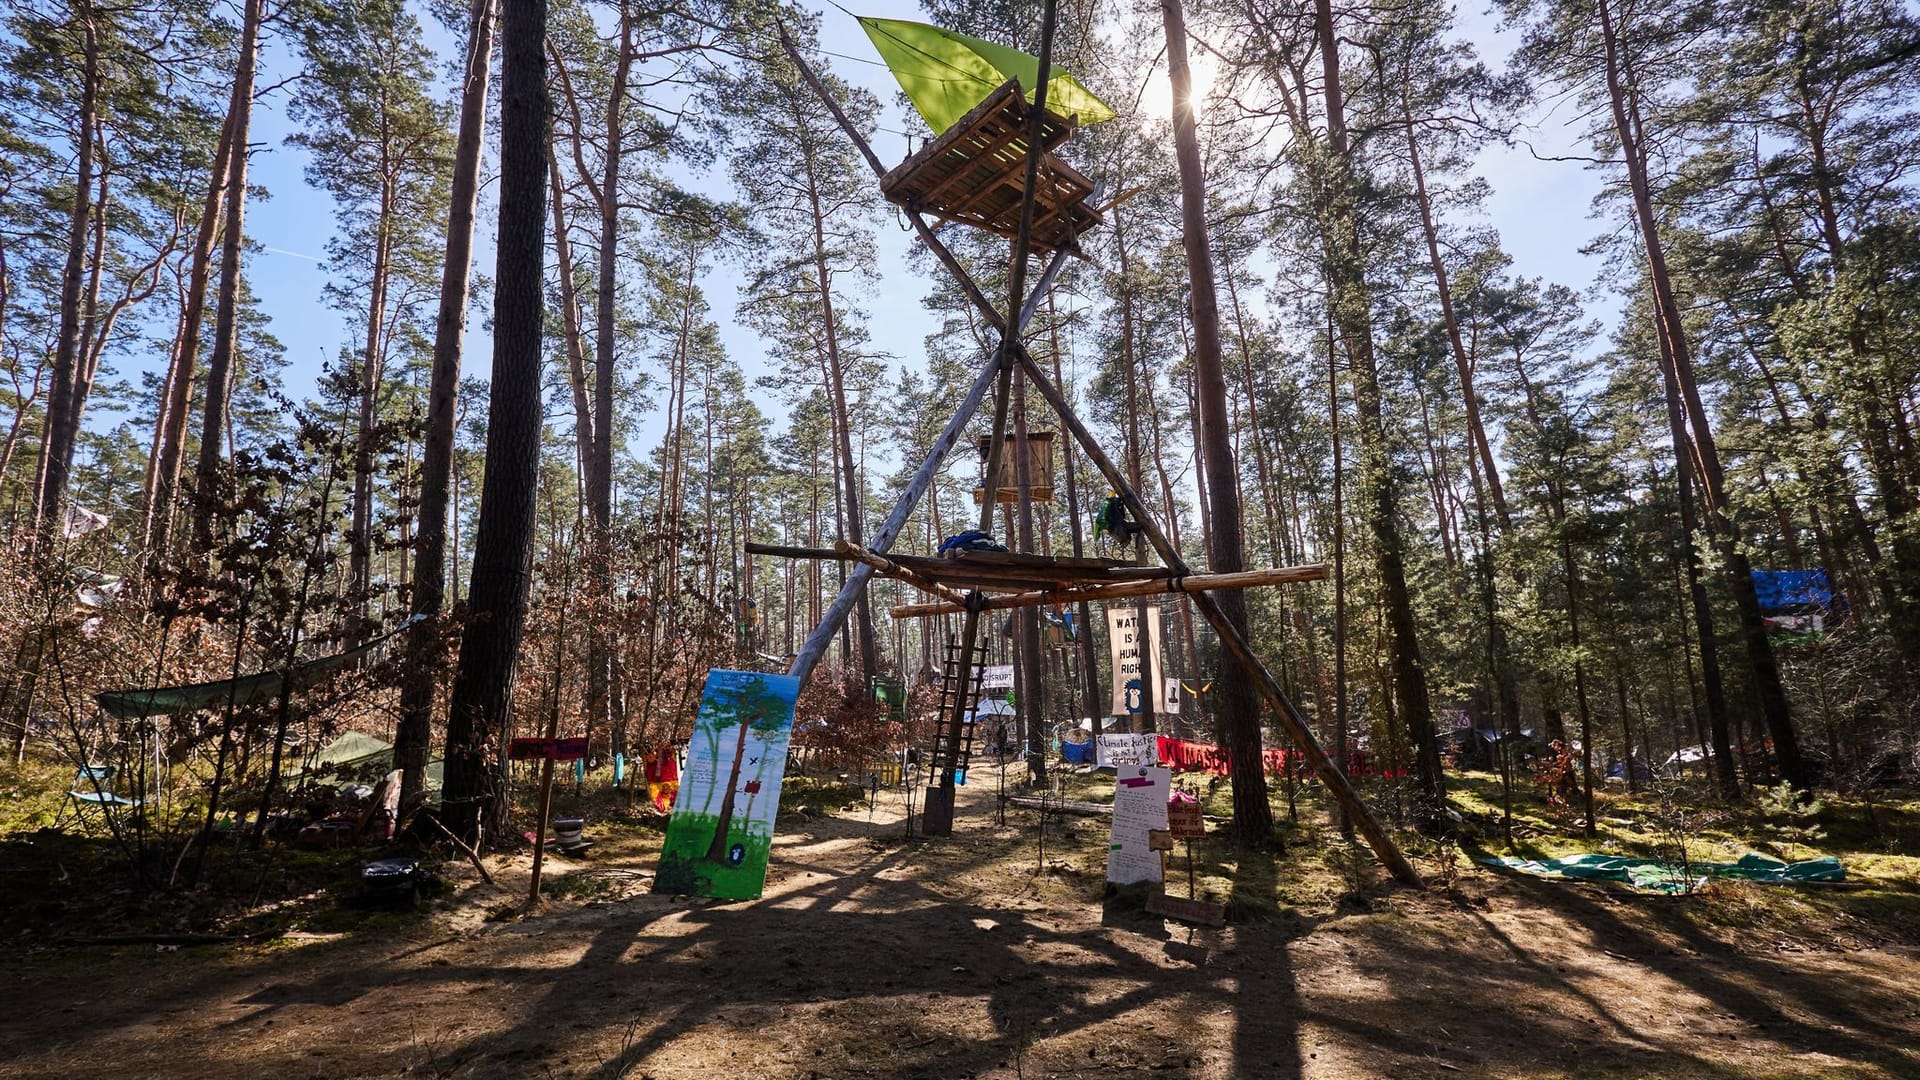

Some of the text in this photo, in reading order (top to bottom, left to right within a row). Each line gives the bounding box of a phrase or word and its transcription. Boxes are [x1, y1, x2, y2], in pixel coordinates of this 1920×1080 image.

[1116, 617, 1139, 628] WAT
[1125, 634, 1132, 643] IS
[1120, 649, 1140, 659] HUM
[1121, 664, 1140, 674] RIGH
